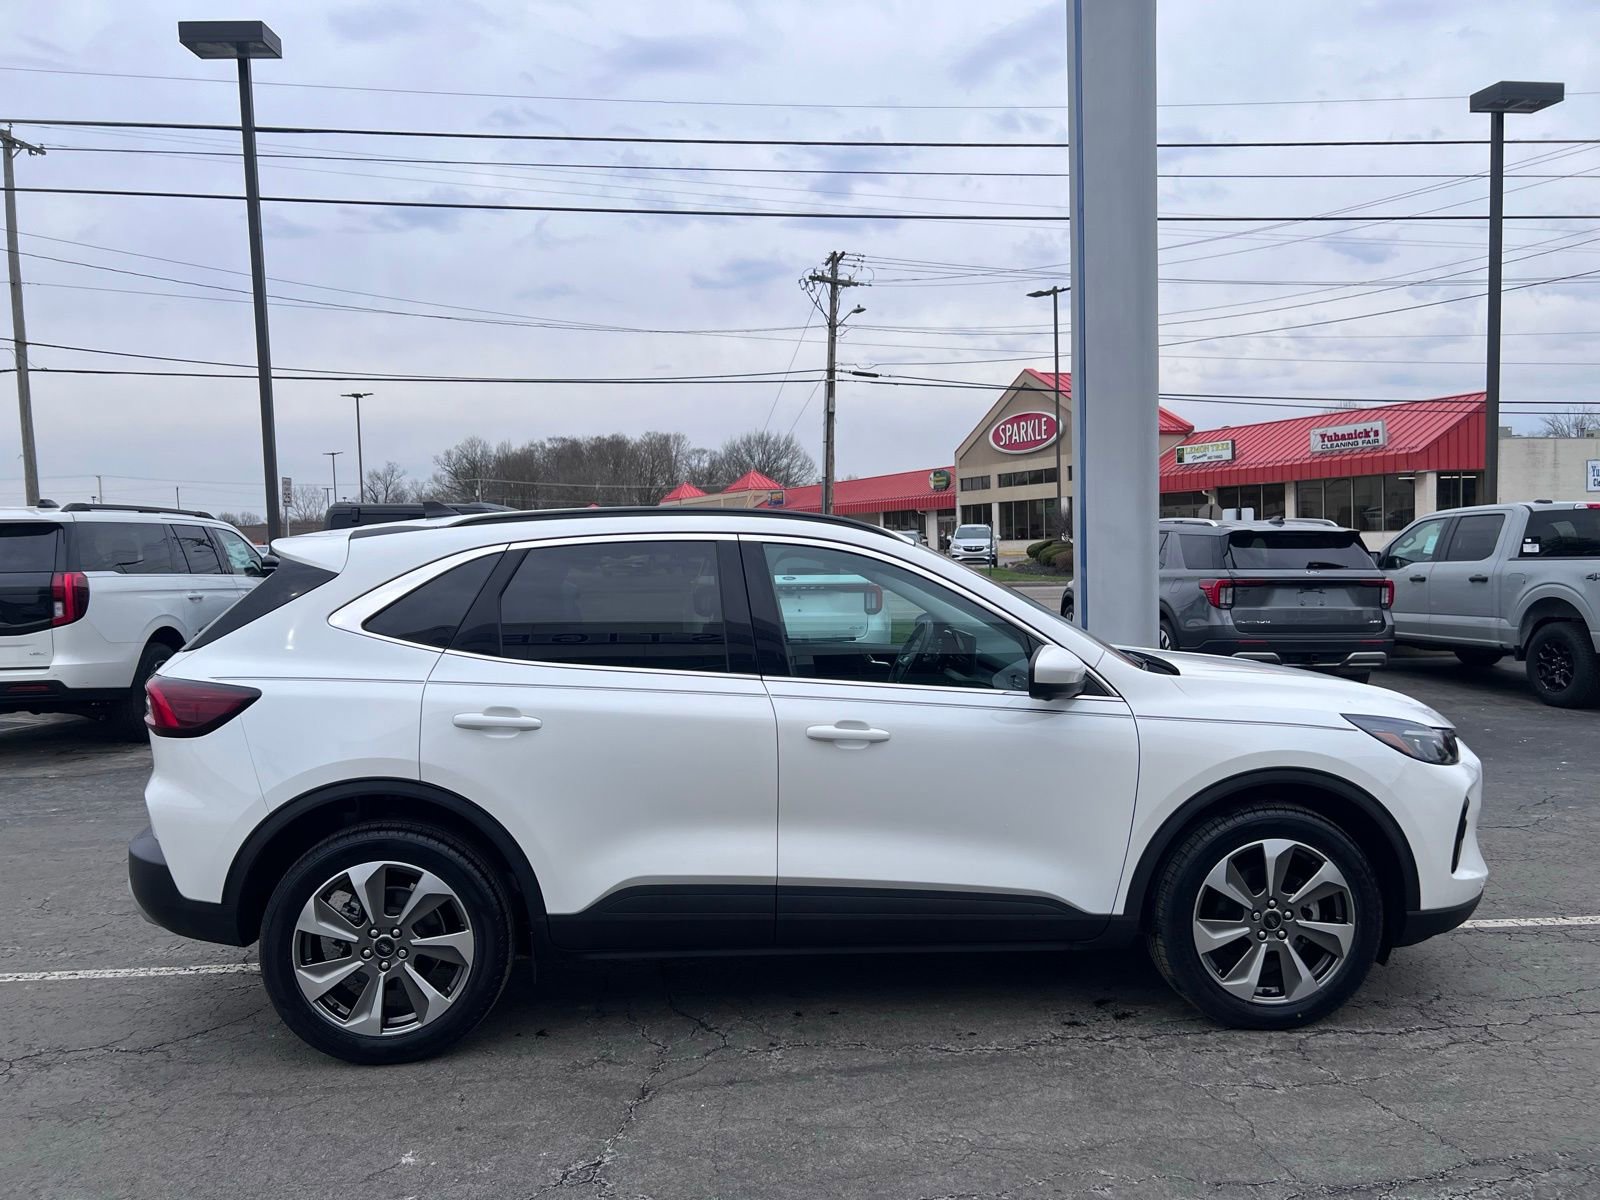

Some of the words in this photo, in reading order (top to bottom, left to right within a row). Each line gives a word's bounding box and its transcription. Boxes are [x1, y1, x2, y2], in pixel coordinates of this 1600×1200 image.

[999, 417, 1047, 445] SPARKLE
[1320, 428, 1379, 443] Yuhanick's
[1185, 444, 1210, 455] LEMON
[1211, 442, 1230, 452] TREE
[1321, 440, 1359, 450] CLEANING
[1362, 438, 1379, 446] FAIR
